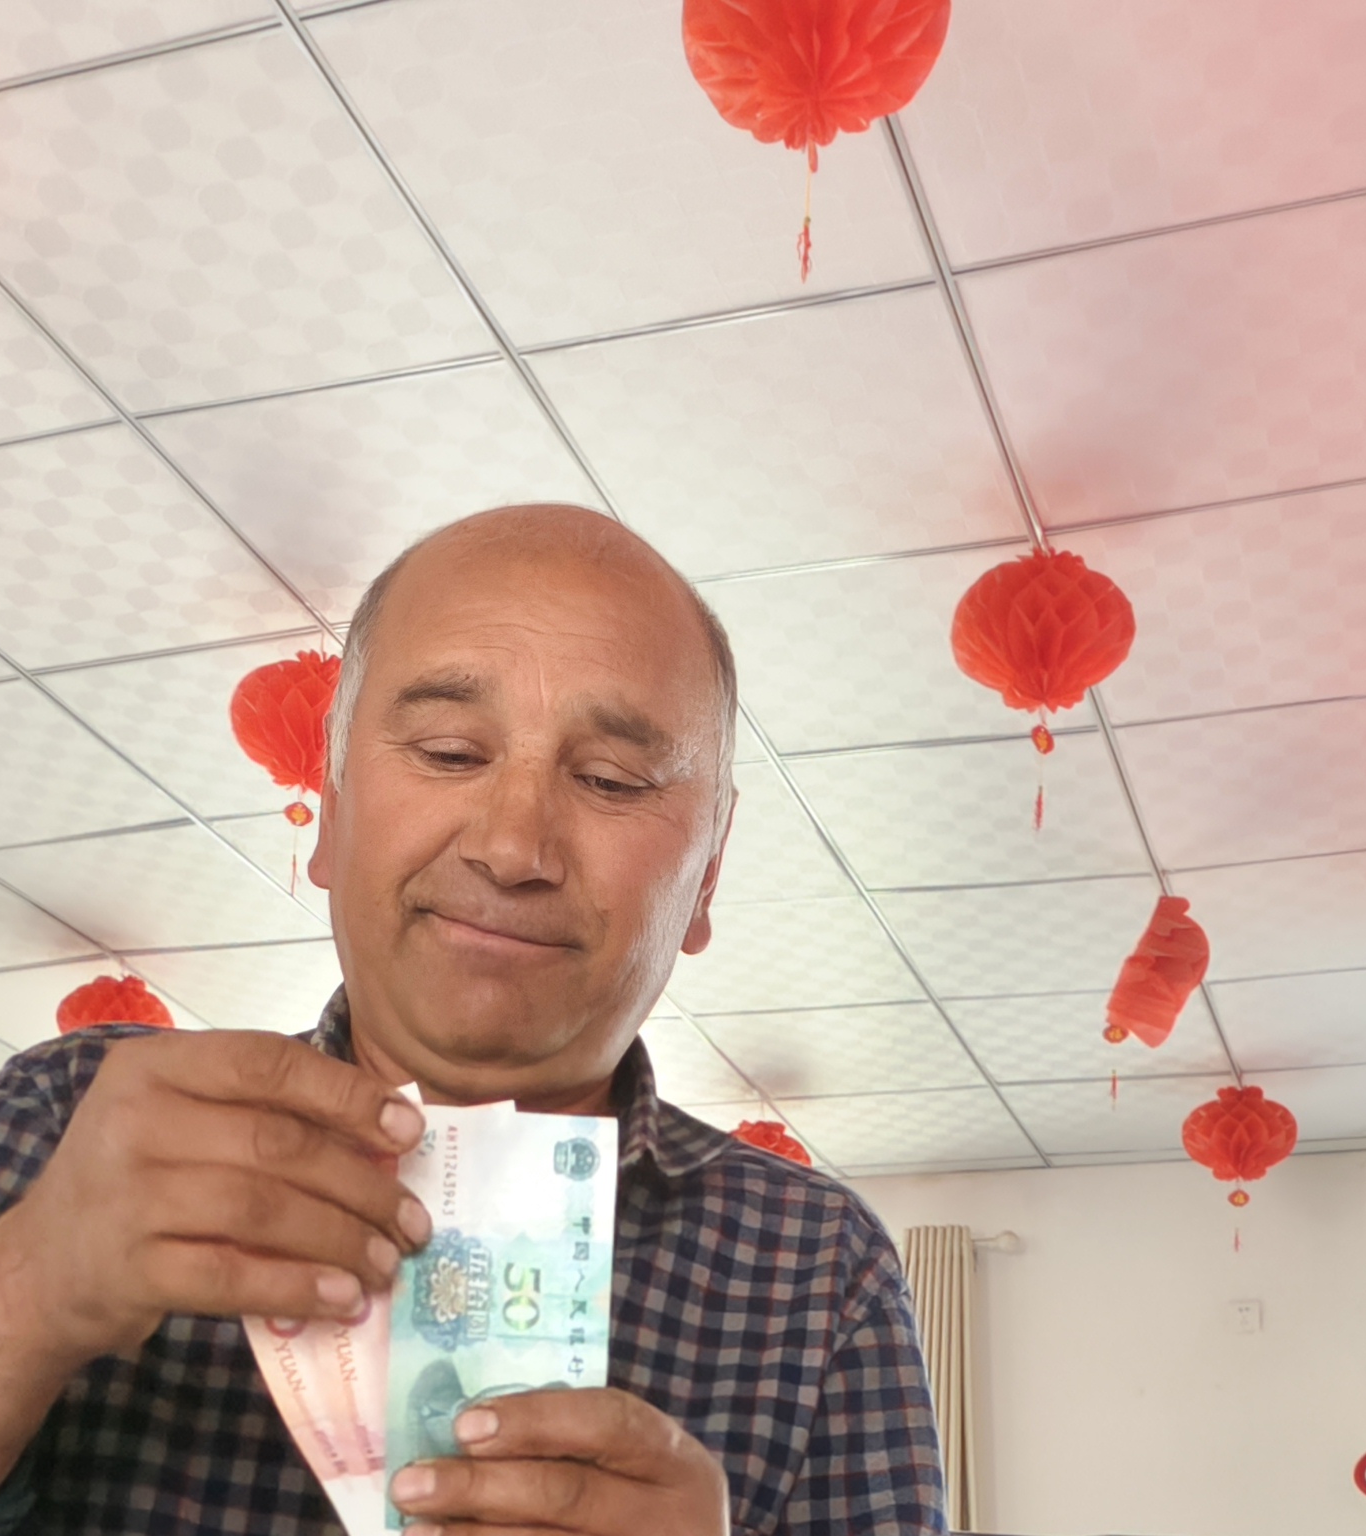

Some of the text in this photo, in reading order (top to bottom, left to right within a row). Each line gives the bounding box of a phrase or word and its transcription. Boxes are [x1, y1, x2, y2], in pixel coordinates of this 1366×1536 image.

[502, 1262, 542, 1331] 50
[567, 1216, 592, 1380] 中国人民银行
[273, 1340, 306, 1393] YUAN
[334, 1329, 358, 1383] YUAN
